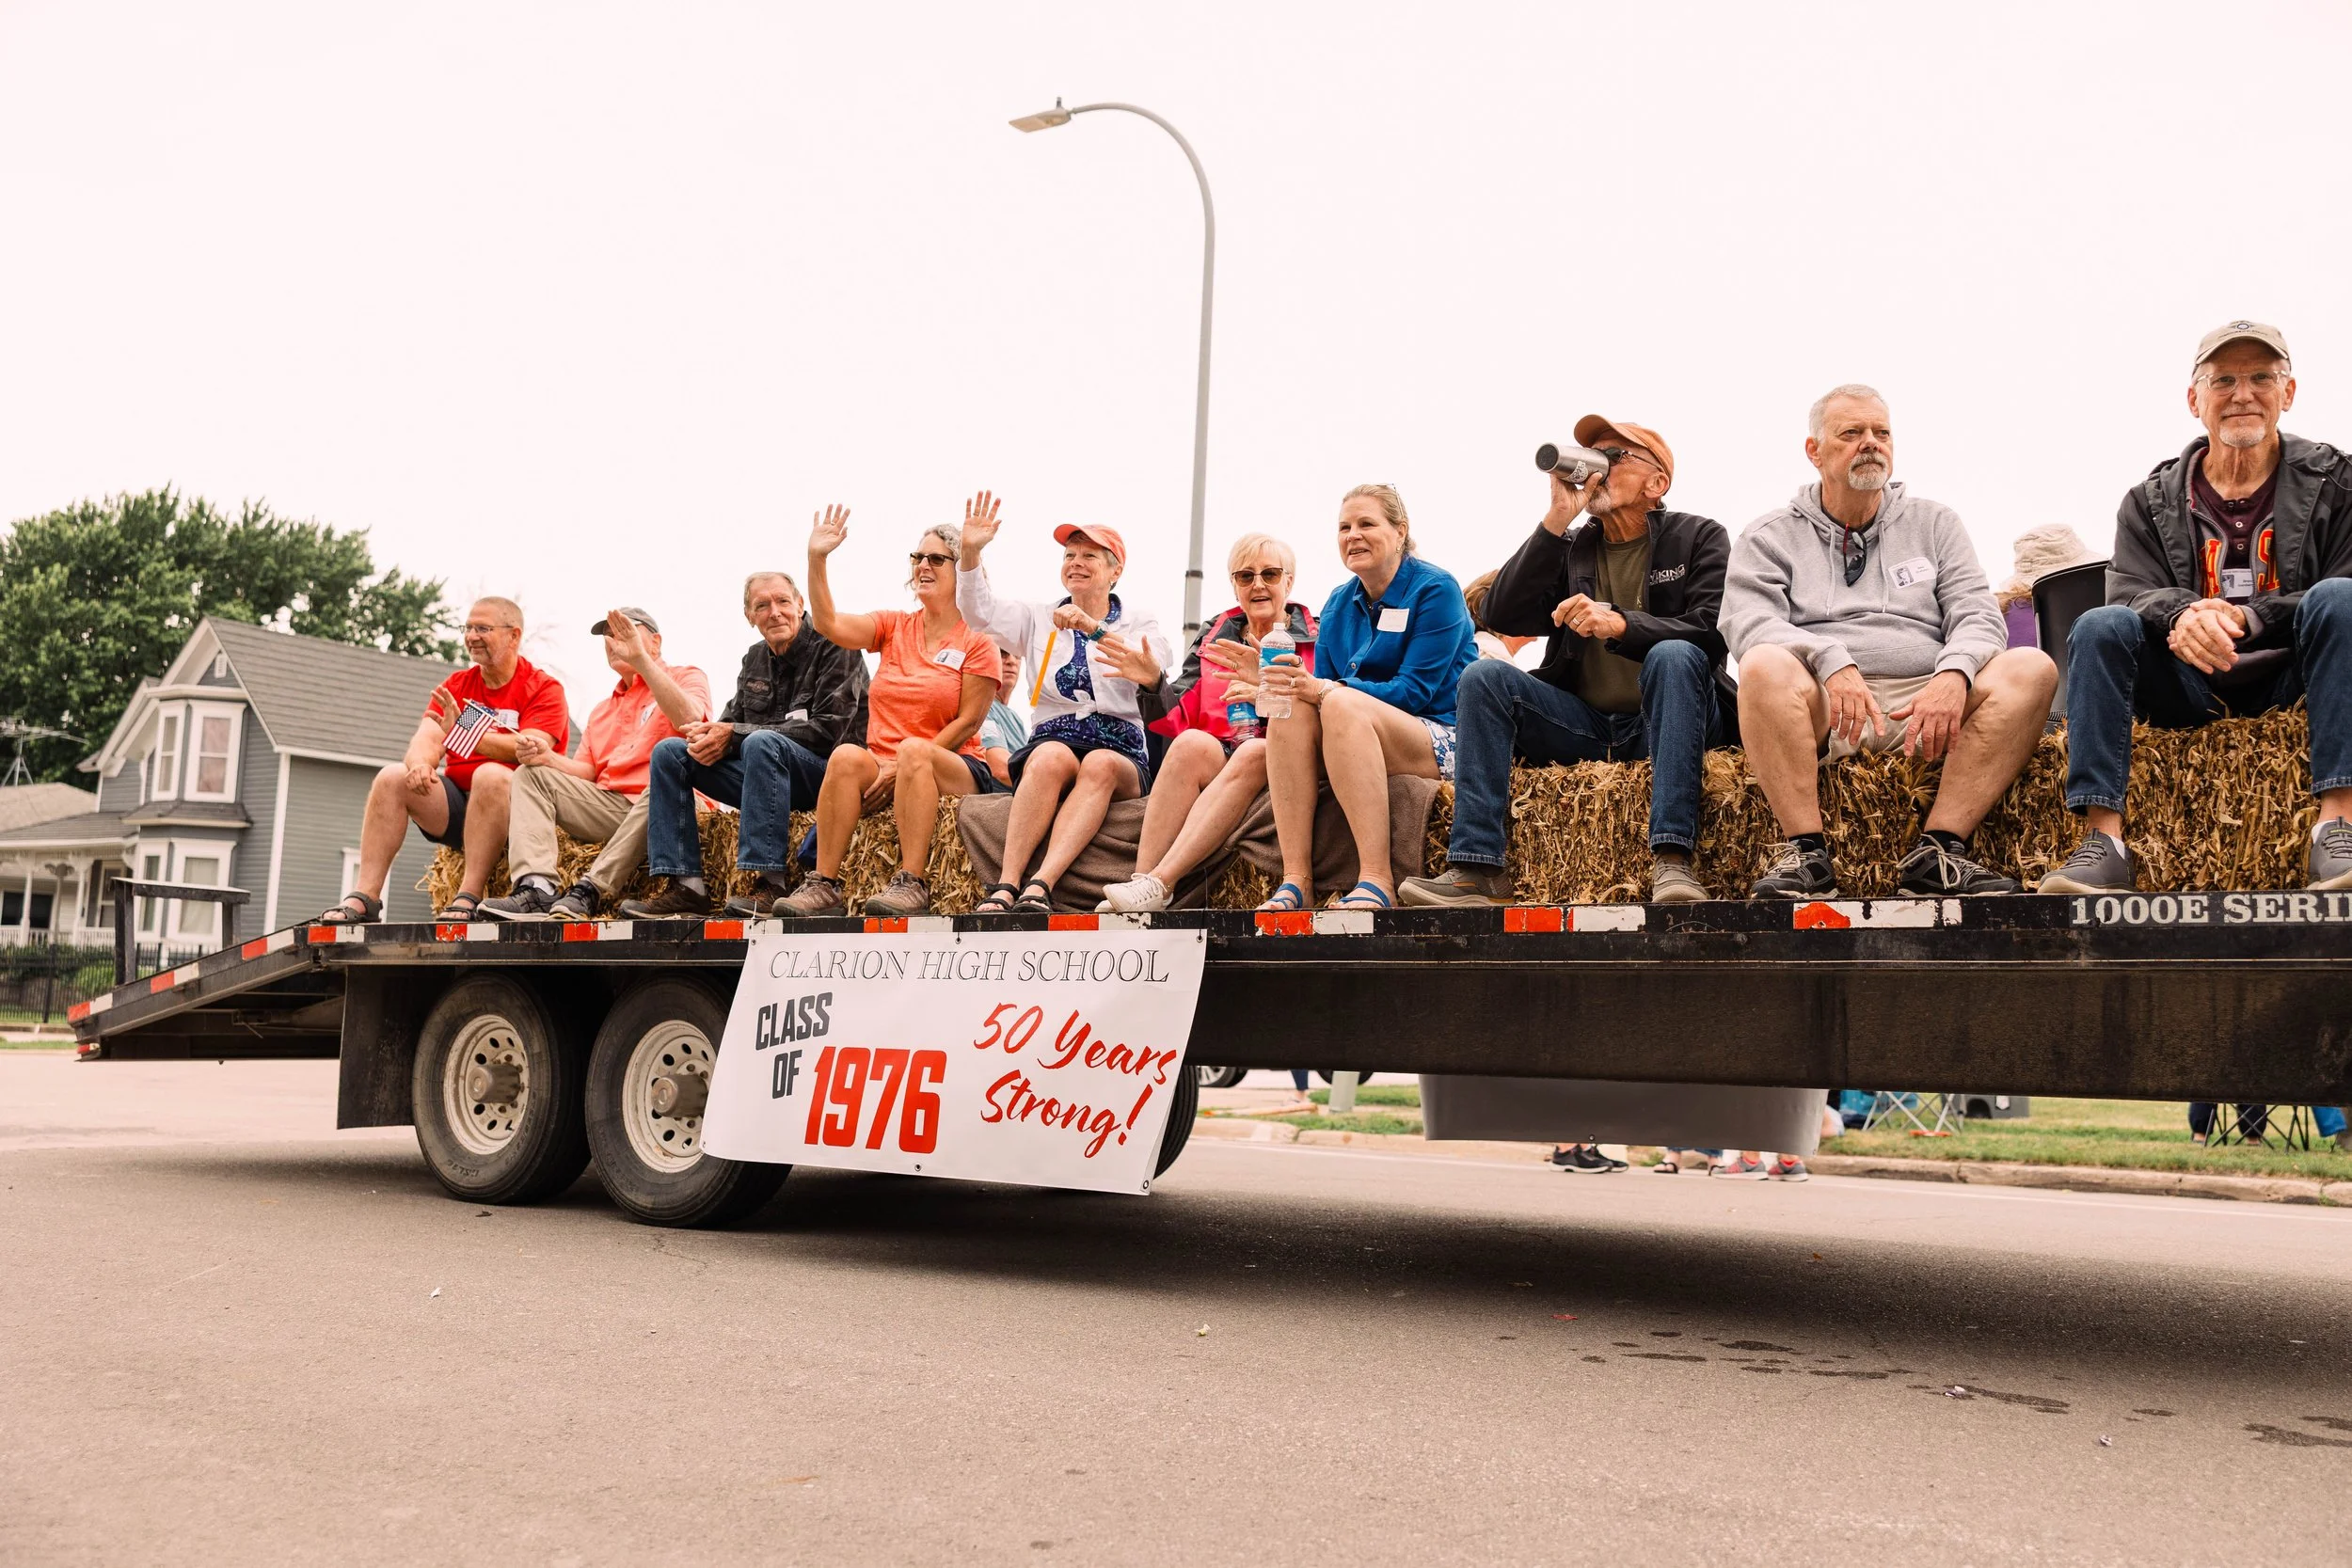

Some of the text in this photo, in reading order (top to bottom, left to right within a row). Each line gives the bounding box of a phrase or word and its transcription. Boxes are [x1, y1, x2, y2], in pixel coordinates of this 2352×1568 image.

[1649, 564, 1685, 582] VIKING
[2072, 893, 2352, 925] 1000E SERI
[770, 949, 1169, 982] CLARION HIGH SCHOOL
[755, 991, 833, 1051] CLASS
[974, 1002, 1177, 1085] 50 Years
[772, 1046, 947, 1154] OF 1976
[980, 1069, 1153, 1158] Strong!
